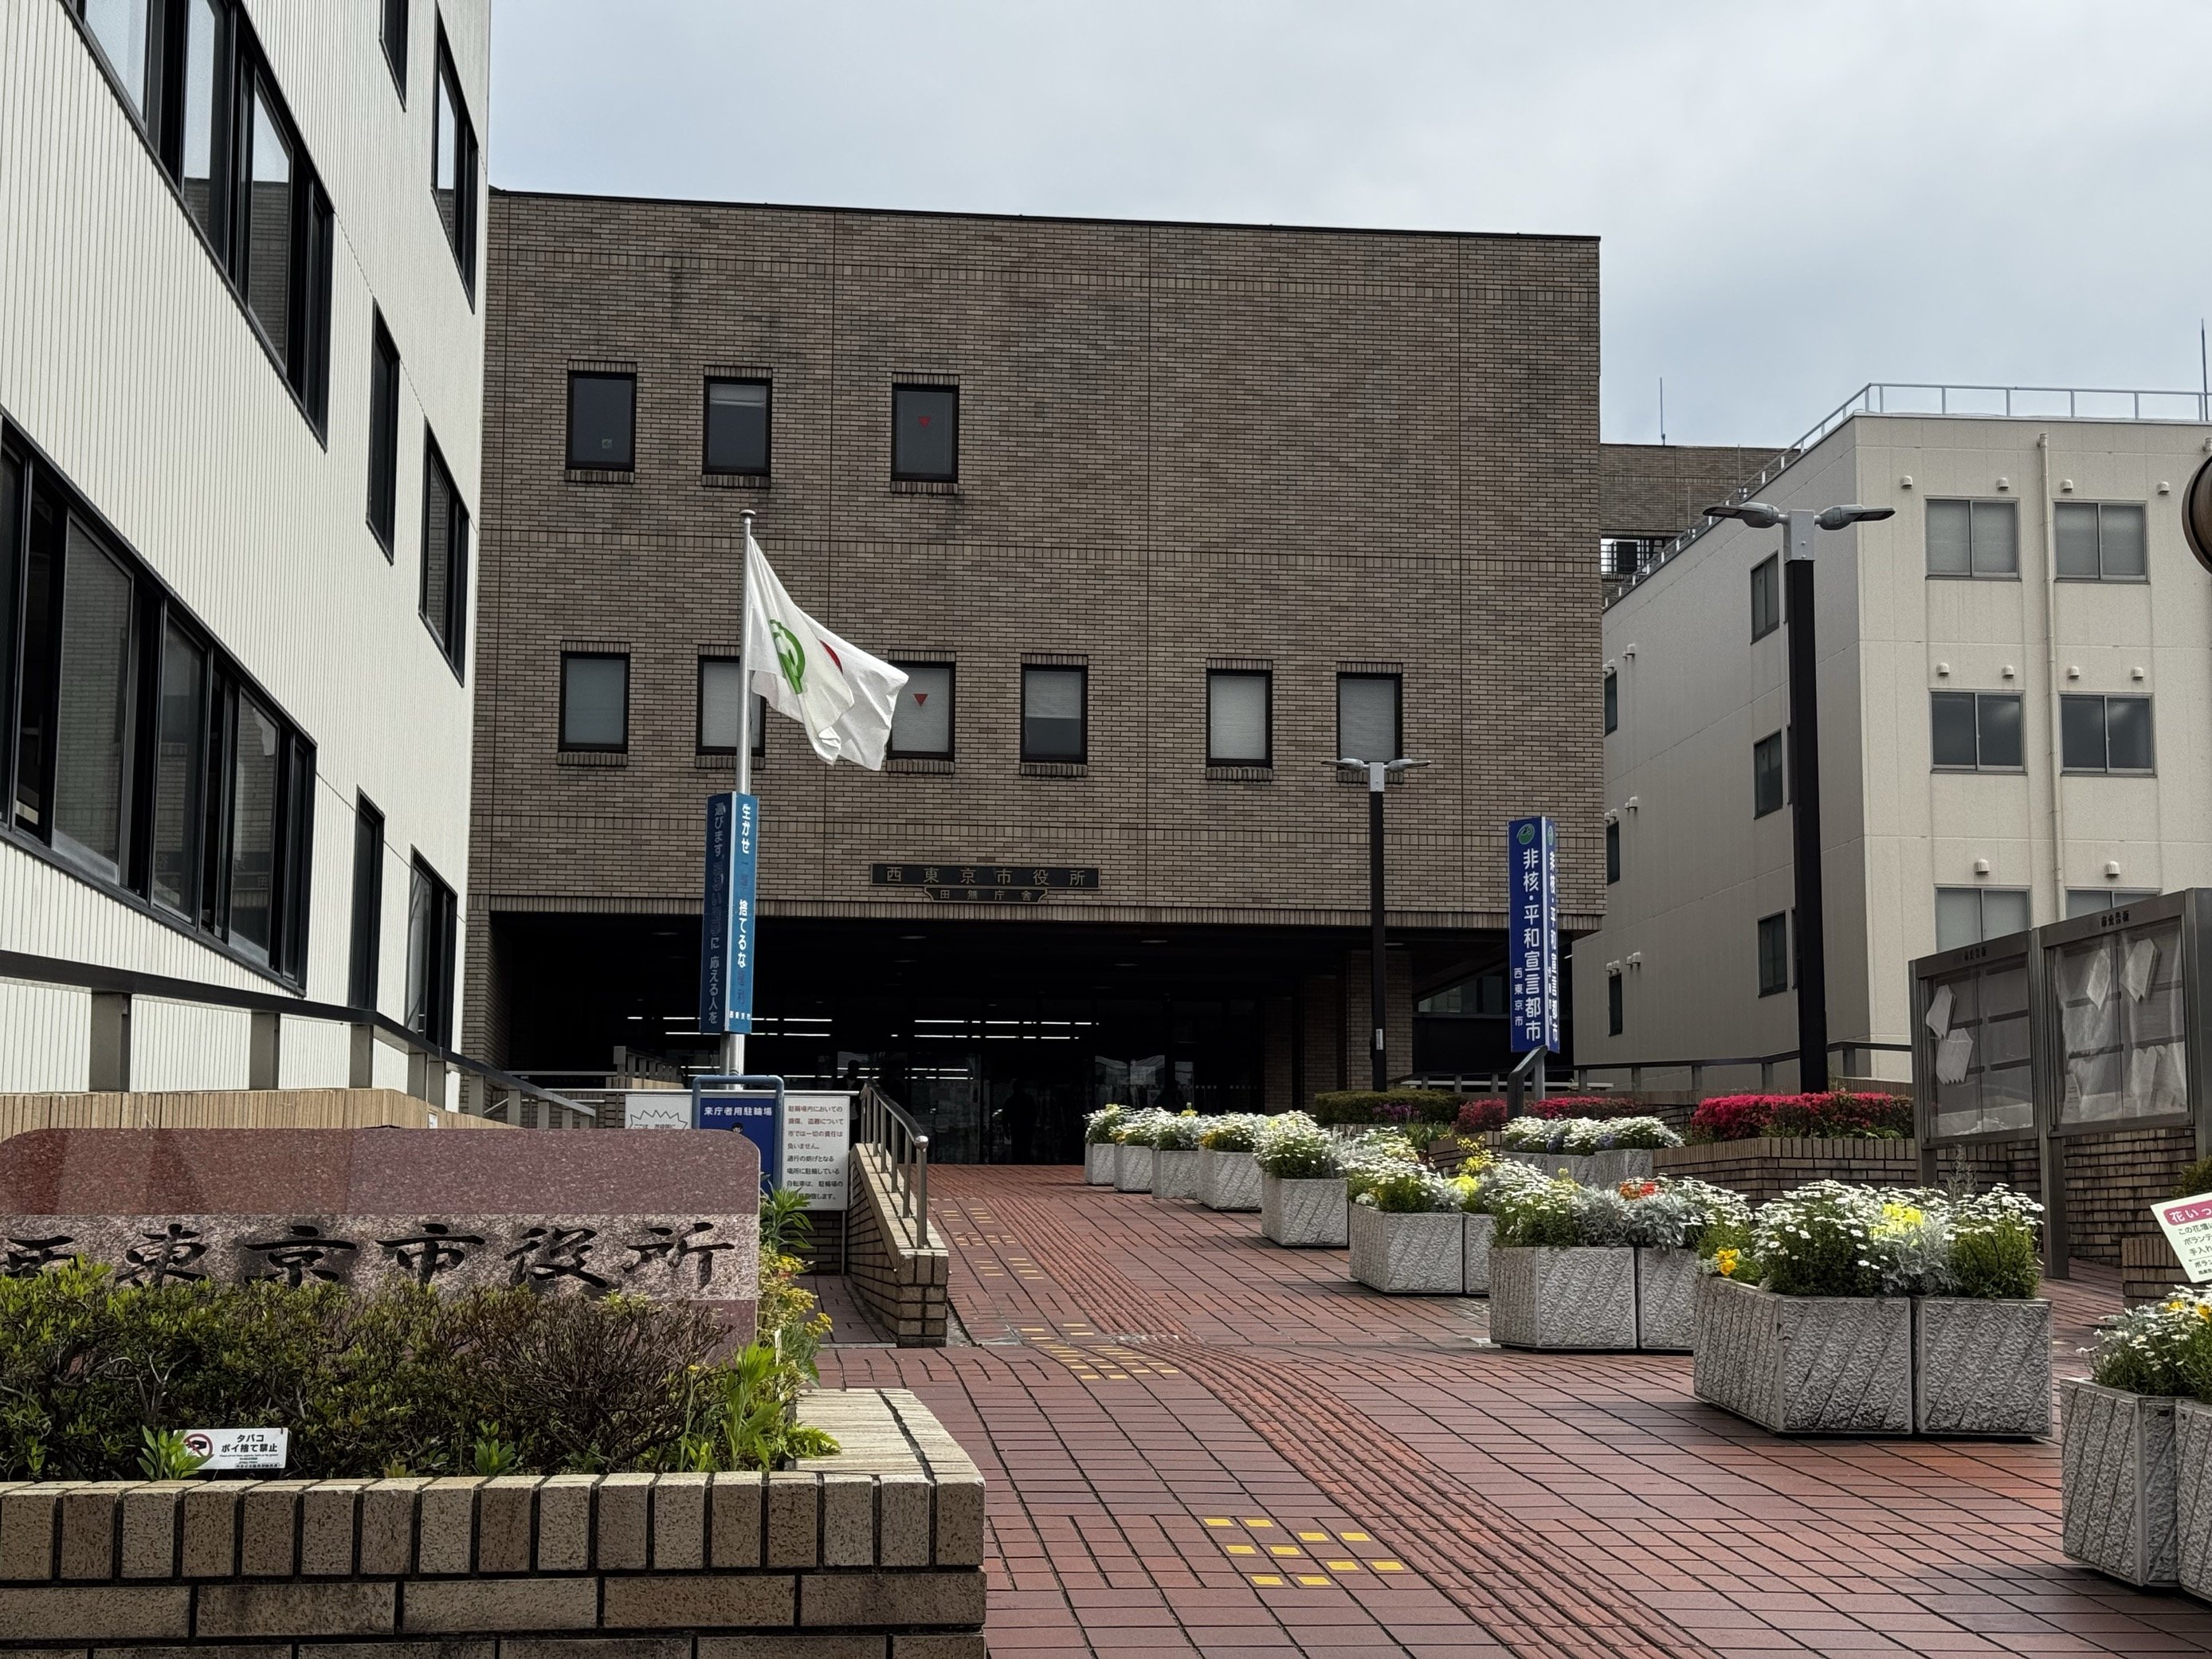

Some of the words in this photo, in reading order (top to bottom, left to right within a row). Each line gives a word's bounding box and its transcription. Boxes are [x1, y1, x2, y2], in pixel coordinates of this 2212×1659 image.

[885, 866, 1086, 886] 西東京市役所
[939, 889, 1033, 901] 田無庁舎
[1523, 848, 1541, 1042] 非核・平和宣言都市
[1513, 967, 1524, 1027] 西東京市
[704, 1106, 773, 1116] 来庁者用駐輪場
[237, 1434, 265, 1443] タバコ
